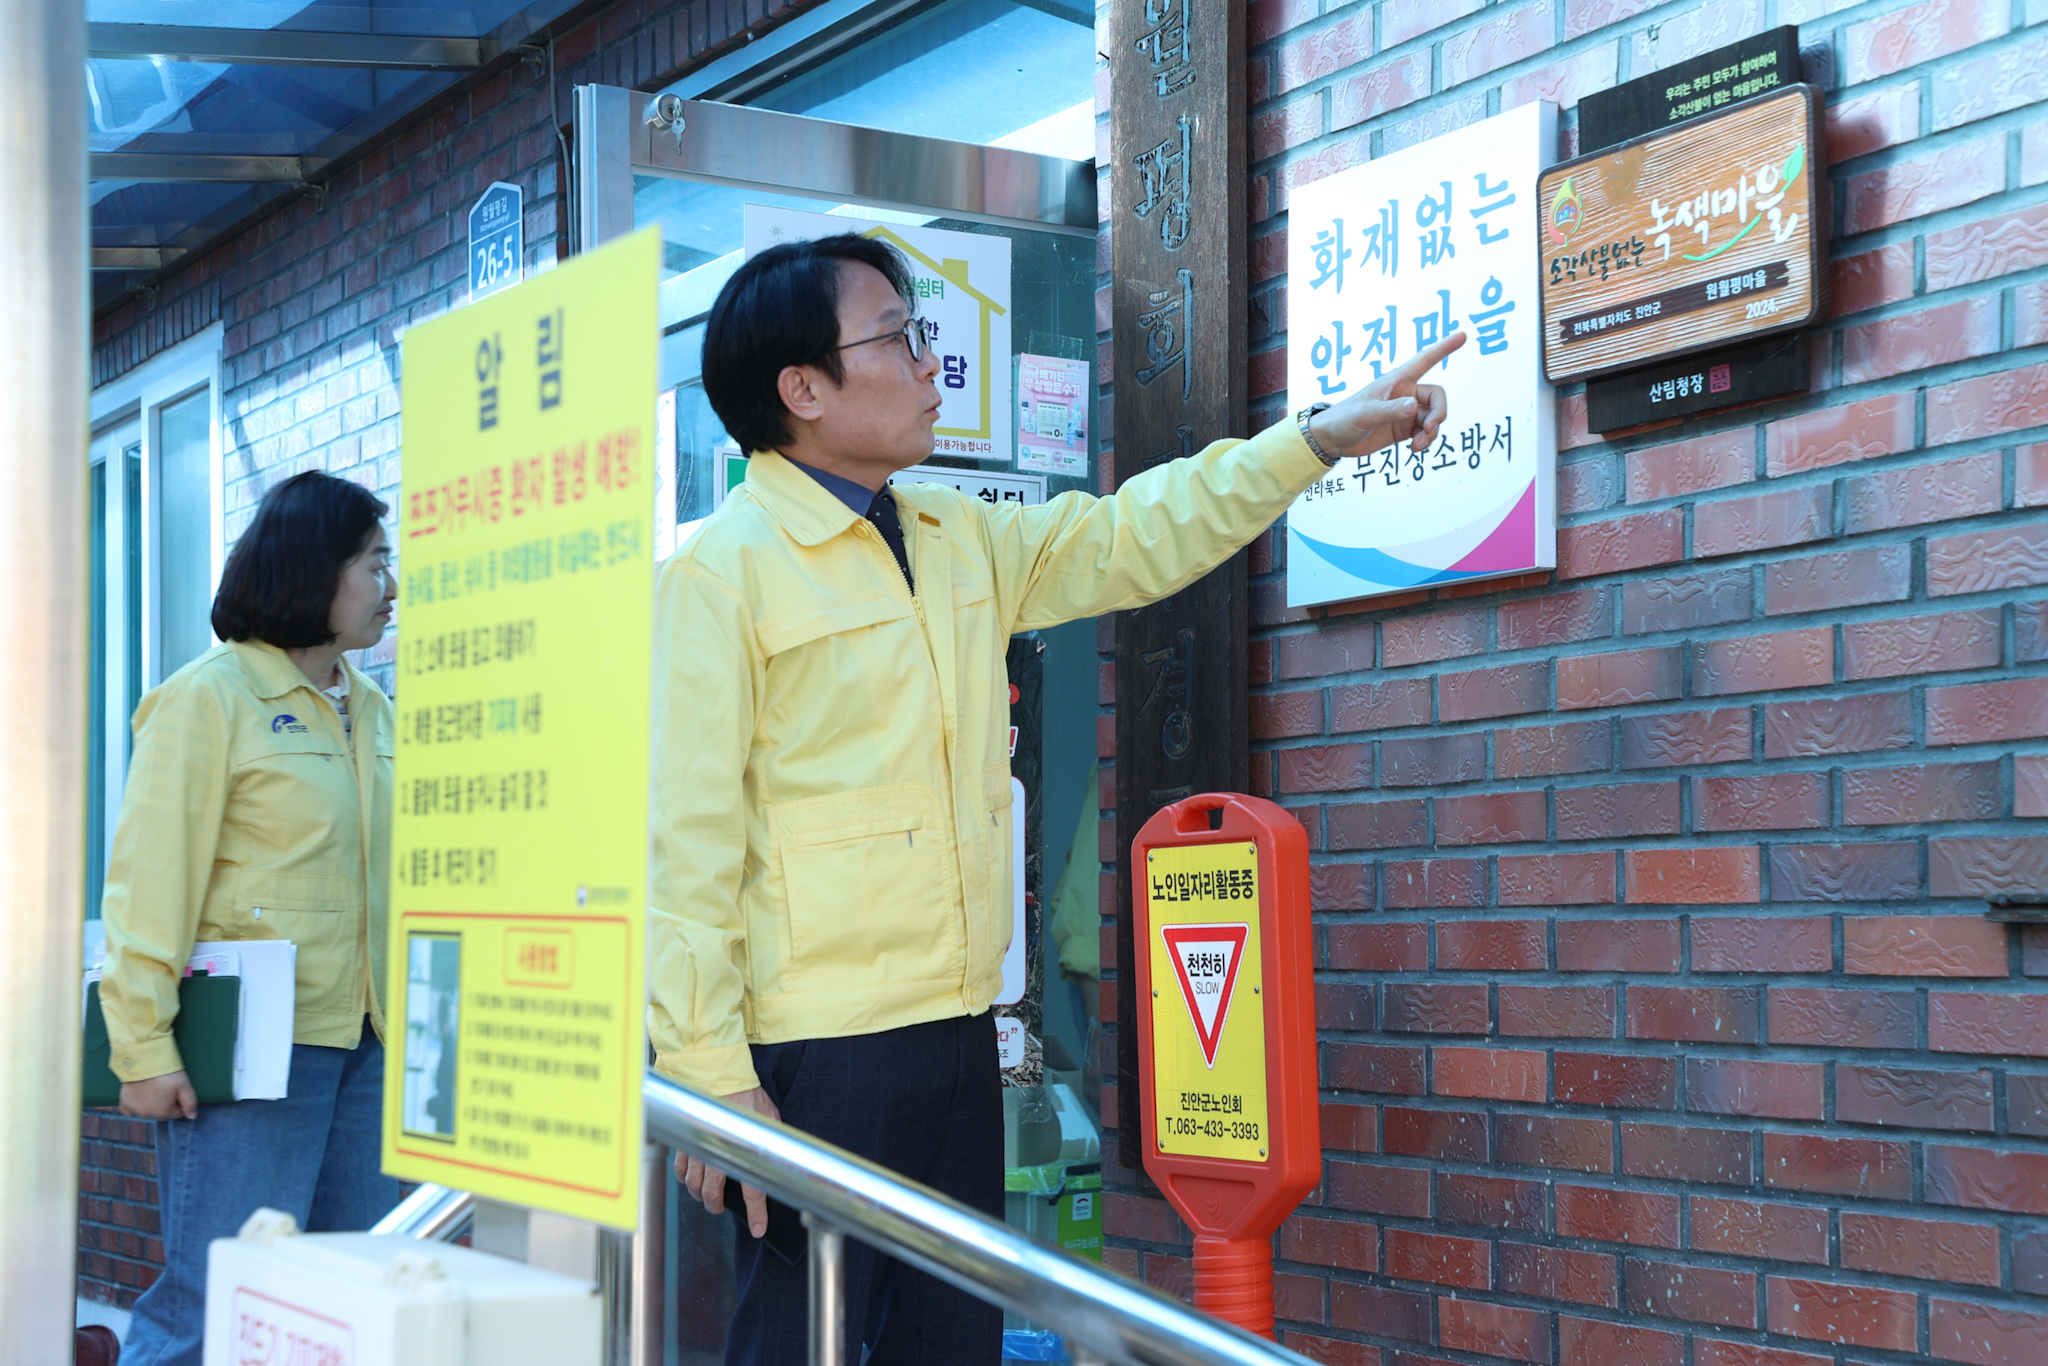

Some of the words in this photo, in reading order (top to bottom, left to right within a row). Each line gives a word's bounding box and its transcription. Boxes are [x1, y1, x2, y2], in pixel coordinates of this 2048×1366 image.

[1666, 82, 1691, 101] 우리는
[1693, 74, 1711, 91] 주민
[1712, 64, 1739, 85] 모두가
[1741, 50, 1777, 76] 참여하여
[1669, 94, 1712, 120] 소각산불이
[1713, 89, 1731, 106] 없는
[1732, 71, 1780, 98] 마을입니다.
[1644, 164, 1799, 261] 녹색마을
[1309, 172, 1516, 295] 화재없는
[477, 234, 513, 290] 26-5
[1705, 269, 1767, 301] 원월평마을
[1573, 309, 1633, 336] 전북특별자치도
[1635, 301, 1662, 320] 진안군
[1311, 275, 1516, 395] 안전마을
[1024, 377, 1081, 396] 무상방문수거
[1039, 369, 1066, 382] 폐가전
[1649, 373, 1705, 403] 산림청장
[935, 438, 995, 453] 이용가능합니다.
[1352, 416, 1512, 493] 무진장소방서
[1153, 869, 1254, 902] 노인일자리활동중
[1187, 953, 1226, 977] 천천히
[1195, 982, 1219, 995] SLOW
[1180, 1092, 1243, 1115] 진안군노인회
[1165, 1116, 1259, 1141] T.063-433-3393
